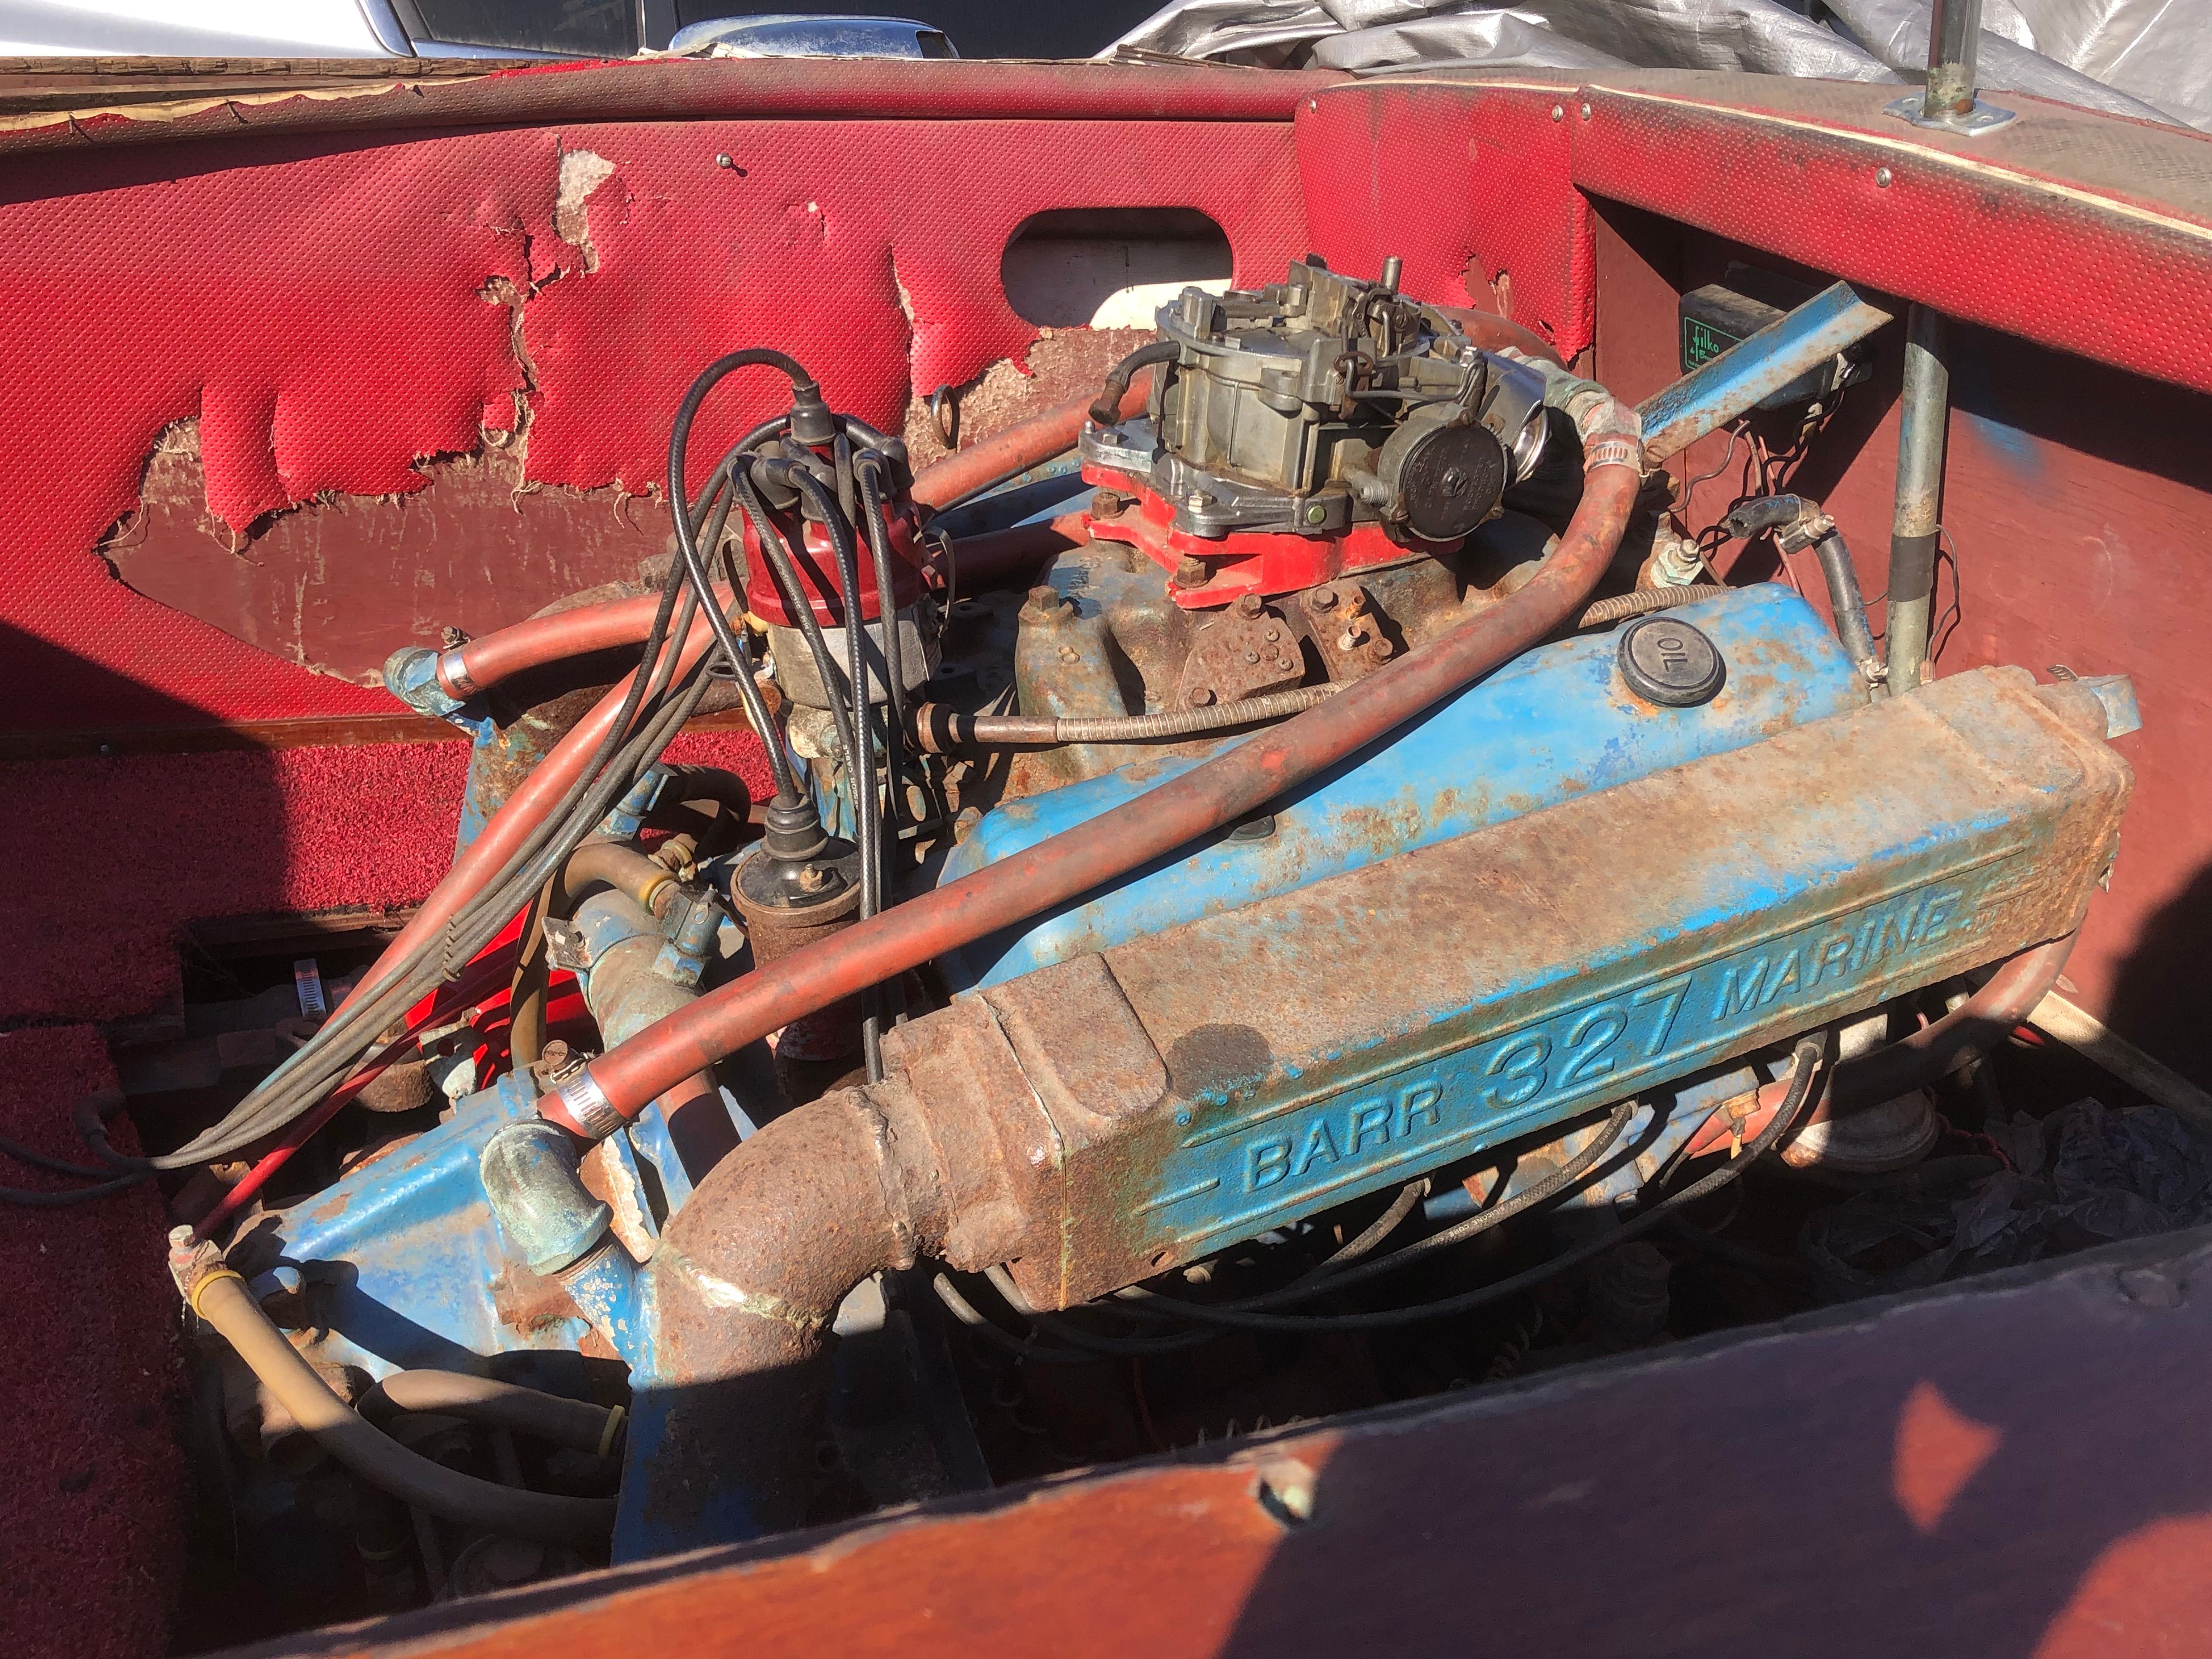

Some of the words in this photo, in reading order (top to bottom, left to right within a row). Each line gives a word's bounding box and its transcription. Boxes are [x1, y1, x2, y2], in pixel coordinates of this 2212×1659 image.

[1692, 326, 1719, 362] filko
[1657, 637, 1688, 672] OIL
[840, 743, 854, 773] CABLE
[1243, 1079, 1443, 1192] BARR
[1485, 974, 1693, 1109] 327
[1711, 896, 1957, 1024] MARINE
[1447, 1222, 1469, 1238] CORE
[1469, 1204, 1505, 1227] SILICONE
